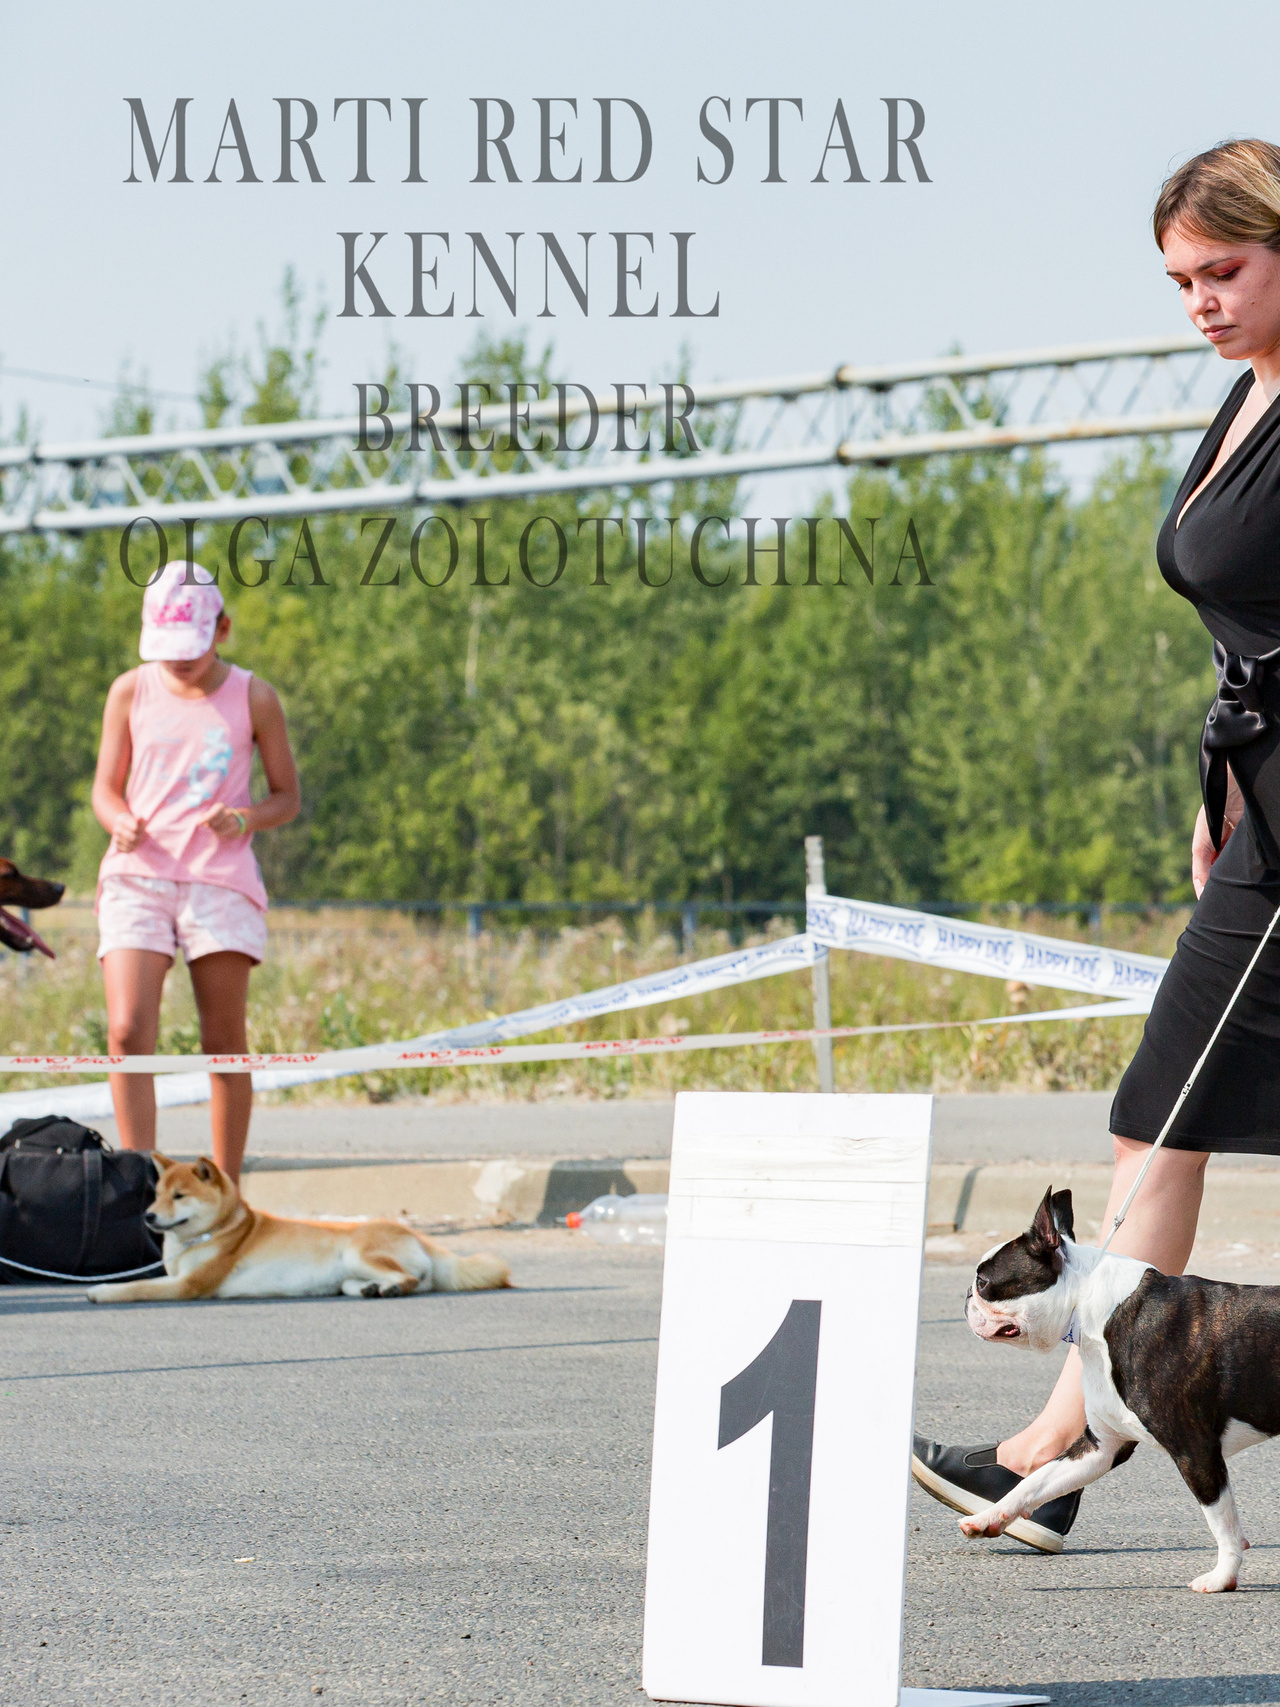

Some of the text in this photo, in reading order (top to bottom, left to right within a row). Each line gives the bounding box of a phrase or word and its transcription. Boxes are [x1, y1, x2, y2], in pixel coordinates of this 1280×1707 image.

[846, 907, 926, 948] HAPPY DOG
[935, 927, 1014, 967] HAPPY DOG
[1022, 943, 1102, 982] HAPPY DOG
[1110, 960, 1160, 988] HAPPY
[717, 1299, 822, 1669] 1
